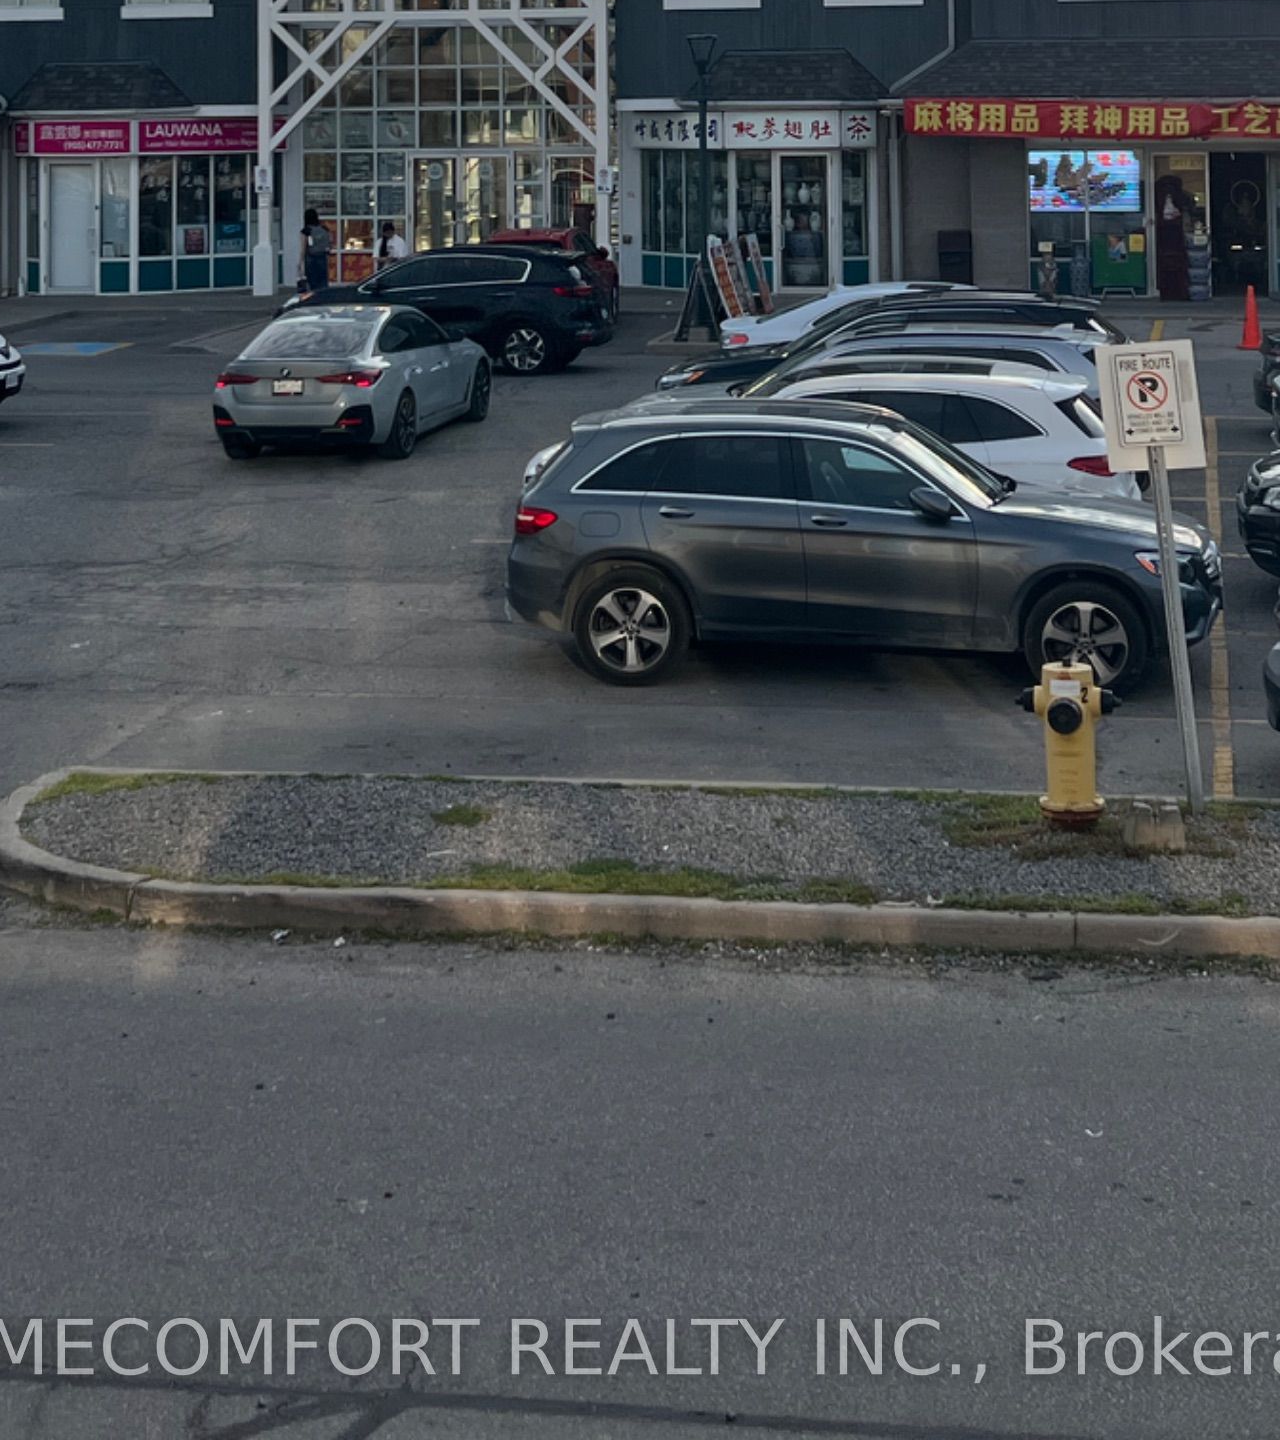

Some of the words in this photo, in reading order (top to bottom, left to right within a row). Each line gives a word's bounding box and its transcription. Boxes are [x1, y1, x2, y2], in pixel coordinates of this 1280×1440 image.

[847, 114, 871, 141] 茶
[913, 103, 1040, 132] 麻将用品
[1059, 104, 1190, 136] 拜神用品
[145, 123, 223, 138] LAUWANA
[1119, 359, 1139, 371] FIRE
[1141, 357, 1171, 370] ROUTE
[1080, 686, 1089, 704] 2
